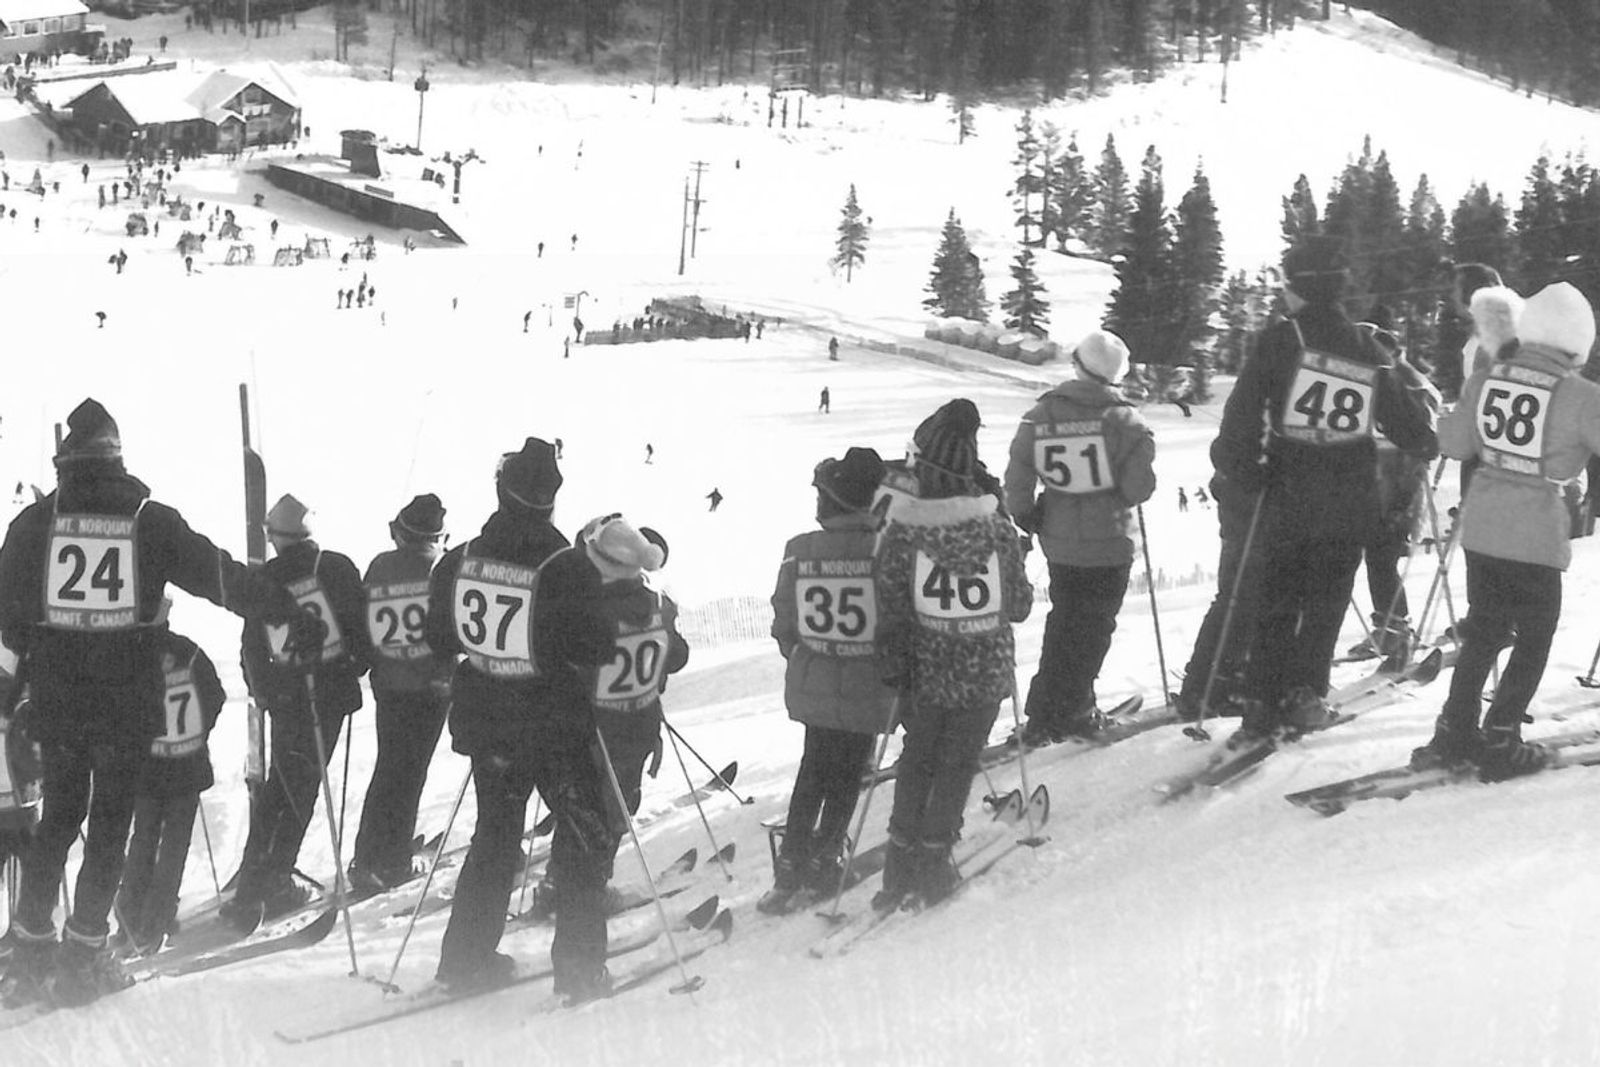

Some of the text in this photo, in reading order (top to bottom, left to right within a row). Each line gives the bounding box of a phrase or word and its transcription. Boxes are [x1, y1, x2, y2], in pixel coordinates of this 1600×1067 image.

[1294, 380, 1364, 432] 48
[1483, 388, 1540, 446] 58
[1044, 443, 1102, 487] 51
[55, 517, 134, 536] MT. NORQUAY
[58, 544, 124, 602] 24
[460, 560, 539, 586] MT. NORQUAY
[820, 560, 874, 576] NORQUAY
[922, 564, 991, 611] 46
[90, 611, 134, 628] CANADA
[376, 603, 427, 644] 29
[462, 589, 523, 651] 37
[804, 586, 867, 637] 35
[488, 659, 535, 675] CANADA
[607, 640, 661, 694] 20
